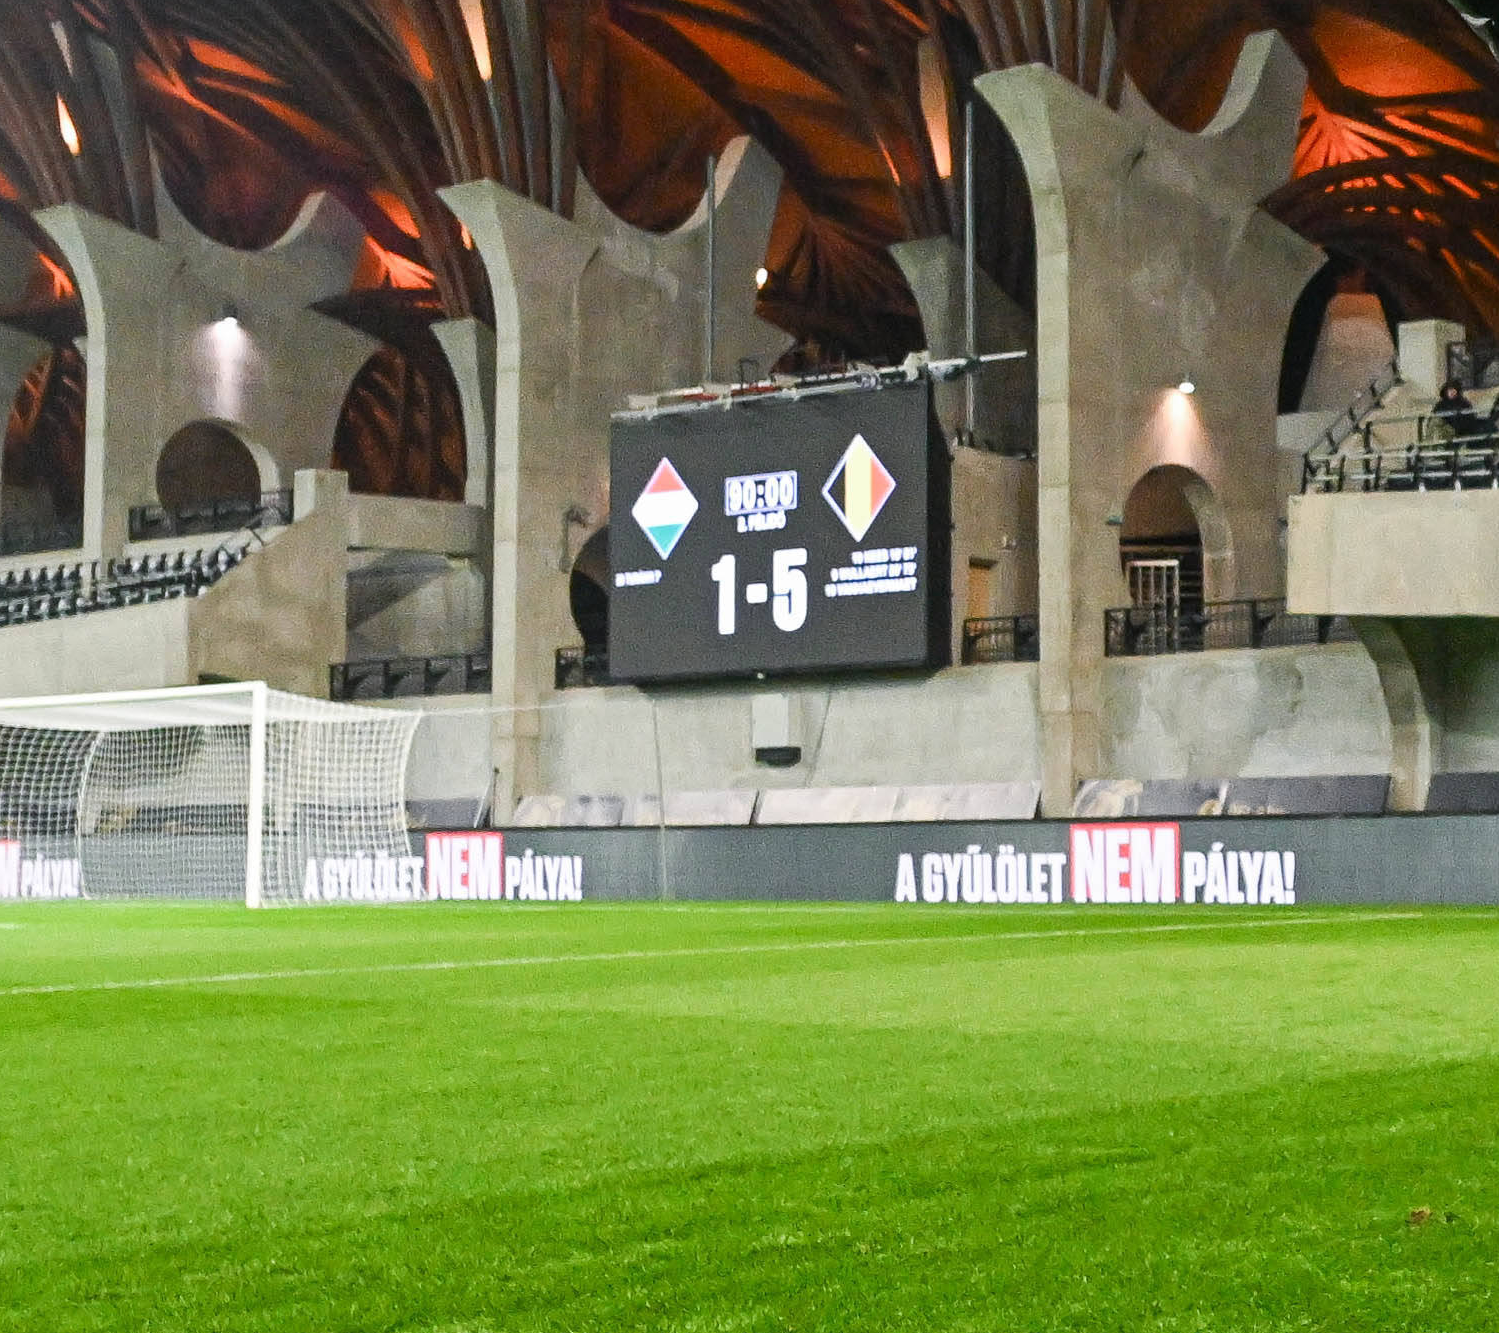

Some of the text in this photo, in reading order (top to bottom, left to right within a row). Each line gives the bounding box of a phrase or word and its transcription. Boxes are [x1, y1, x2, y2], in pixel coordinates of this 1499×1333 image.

[304, 857, 320, 900] A
[428, 835, 501, 900] NEM
[505, 848, 583, 901] PÁLYA!
[895, 853, 917, 902] A
[1072, 827, 1177, 904] NEM
[1183, 841, 1296, 904] PÁLYA!
